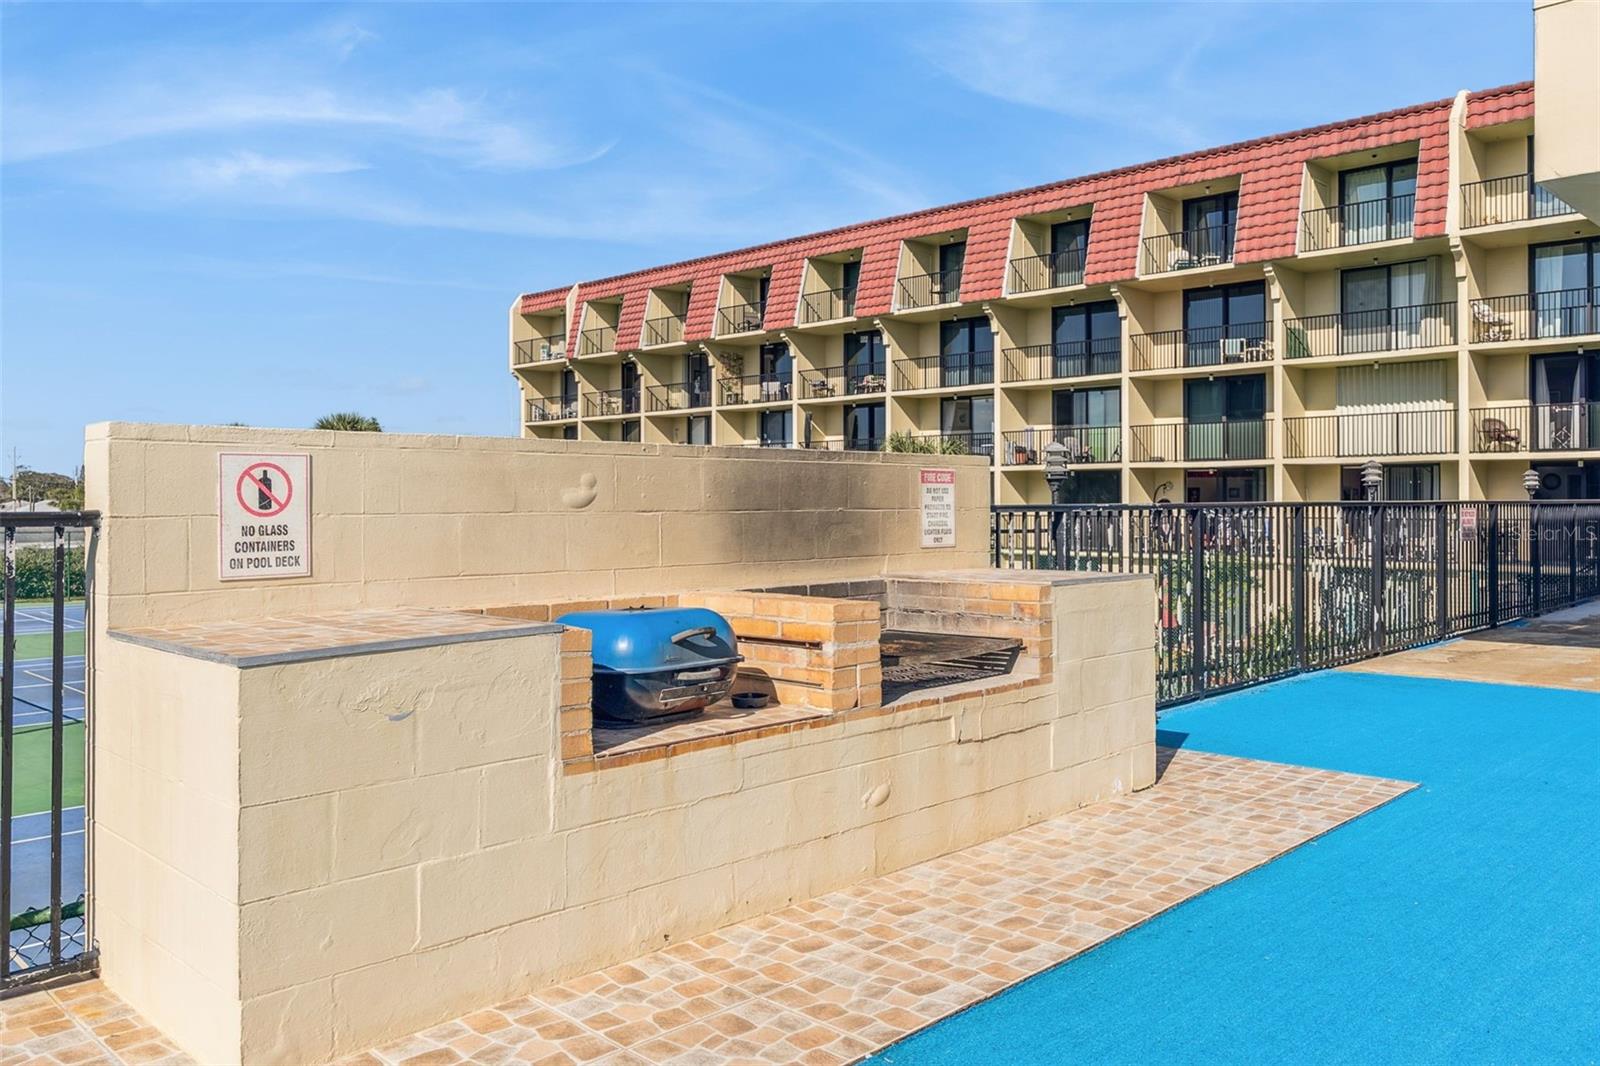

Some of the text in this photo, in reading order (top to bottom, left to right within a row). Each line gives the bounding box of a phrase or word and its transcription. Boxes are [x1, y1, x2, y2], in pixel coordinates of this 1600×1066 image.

[241, 524, 289, 537] NO GLASS
[234, 540, 295, 553] CONTAINERS
[229, 555, 301, 569] ON POOL DECK
